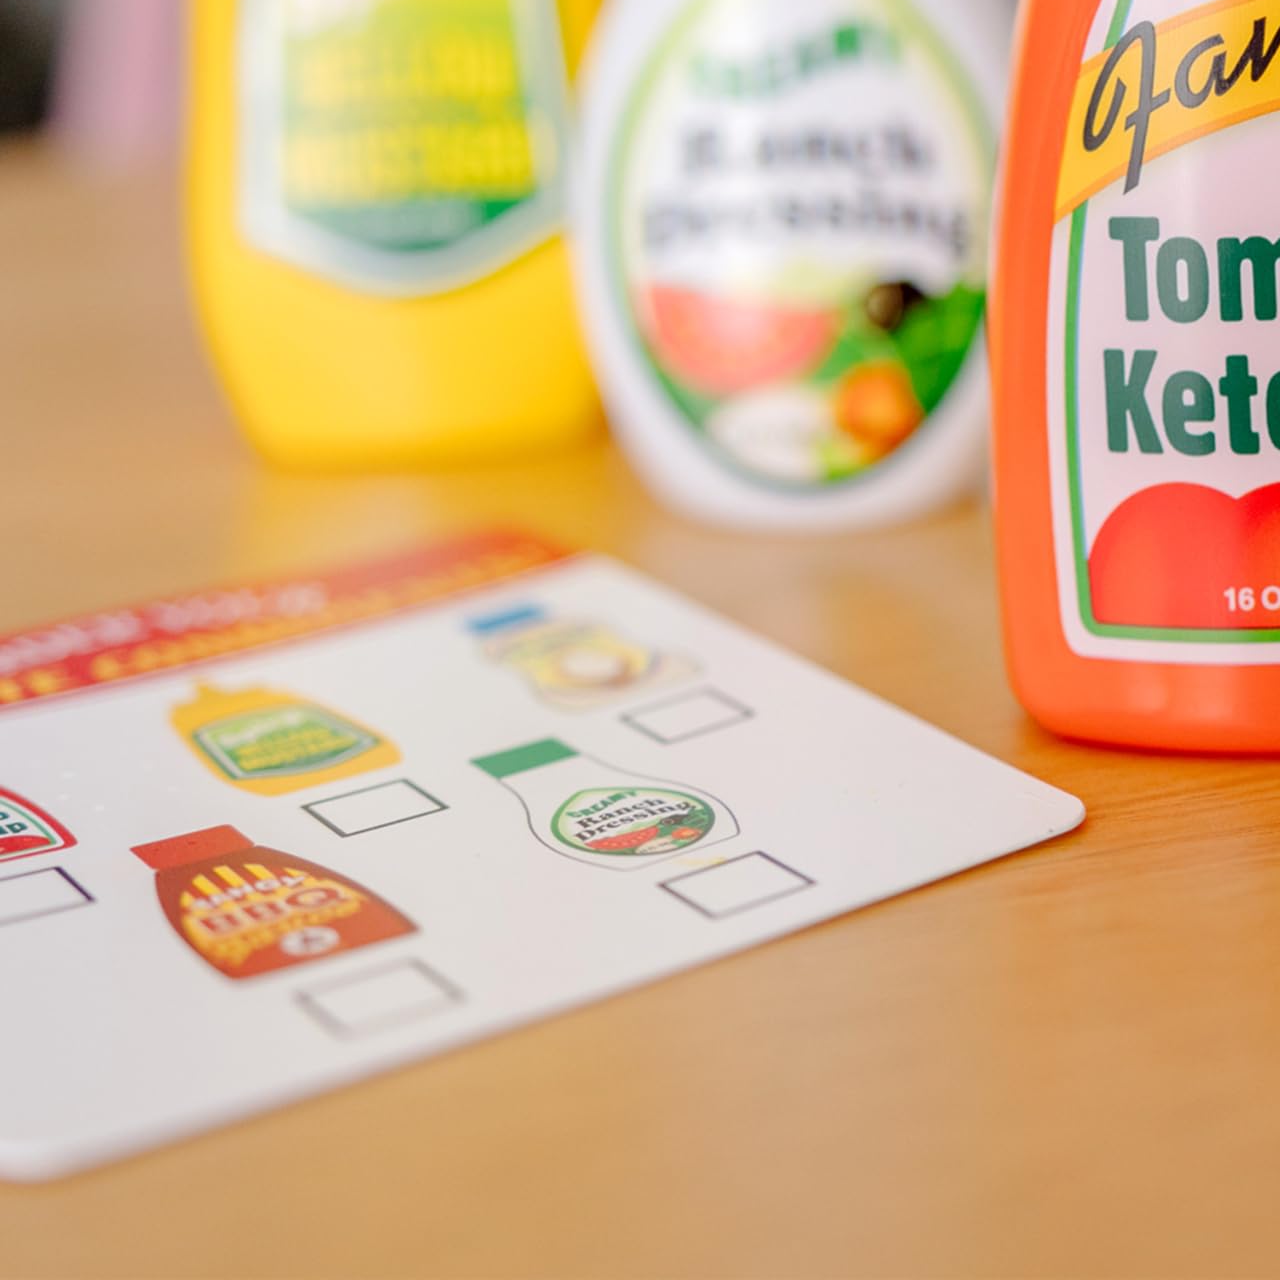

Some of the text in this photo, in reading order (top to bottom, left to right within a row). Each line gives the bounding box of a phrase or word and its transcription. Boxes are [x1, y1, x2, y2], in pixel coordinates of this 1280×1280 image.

[1223, 586, 1256, 612] 16
[566, 789, 638, 819] CREAMY
[576, 797, 666, 829] Ranch
[573, 800, 697, 843] Dressing
